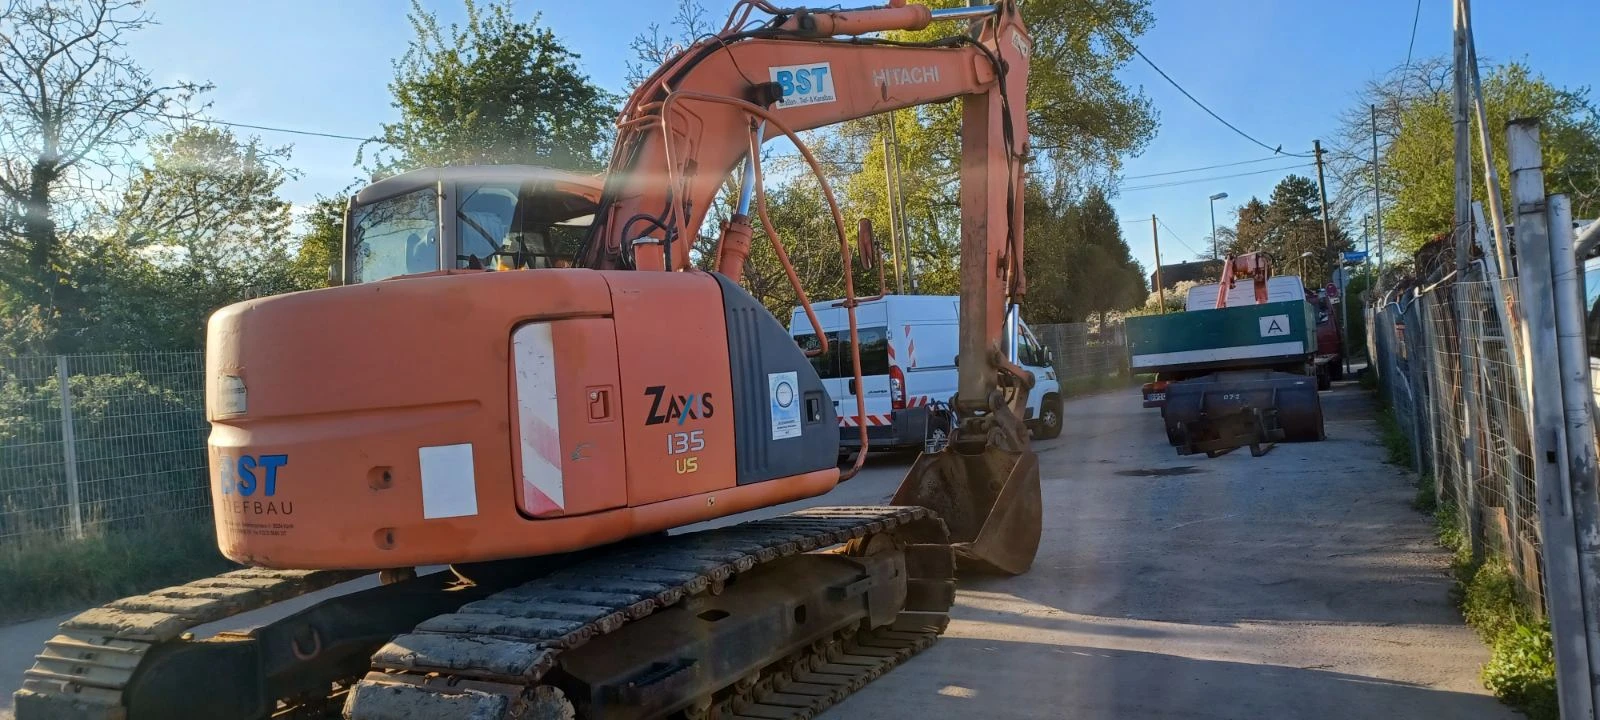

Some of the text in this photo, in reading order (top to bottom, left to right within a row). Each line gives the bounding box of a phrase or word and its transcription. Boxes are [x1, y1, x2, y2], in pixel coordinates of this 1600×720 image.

[777, 67, 828, 97] BST
[873, 66, 940, 87] HITACHI
[1267, 319, 1284, 334] A
[667, 430, 705, 455] 135
[220, 454, 288, 497] BST
[676, 456, 698, 475] US
[222, 499, 293, 516] TIEFBAU
